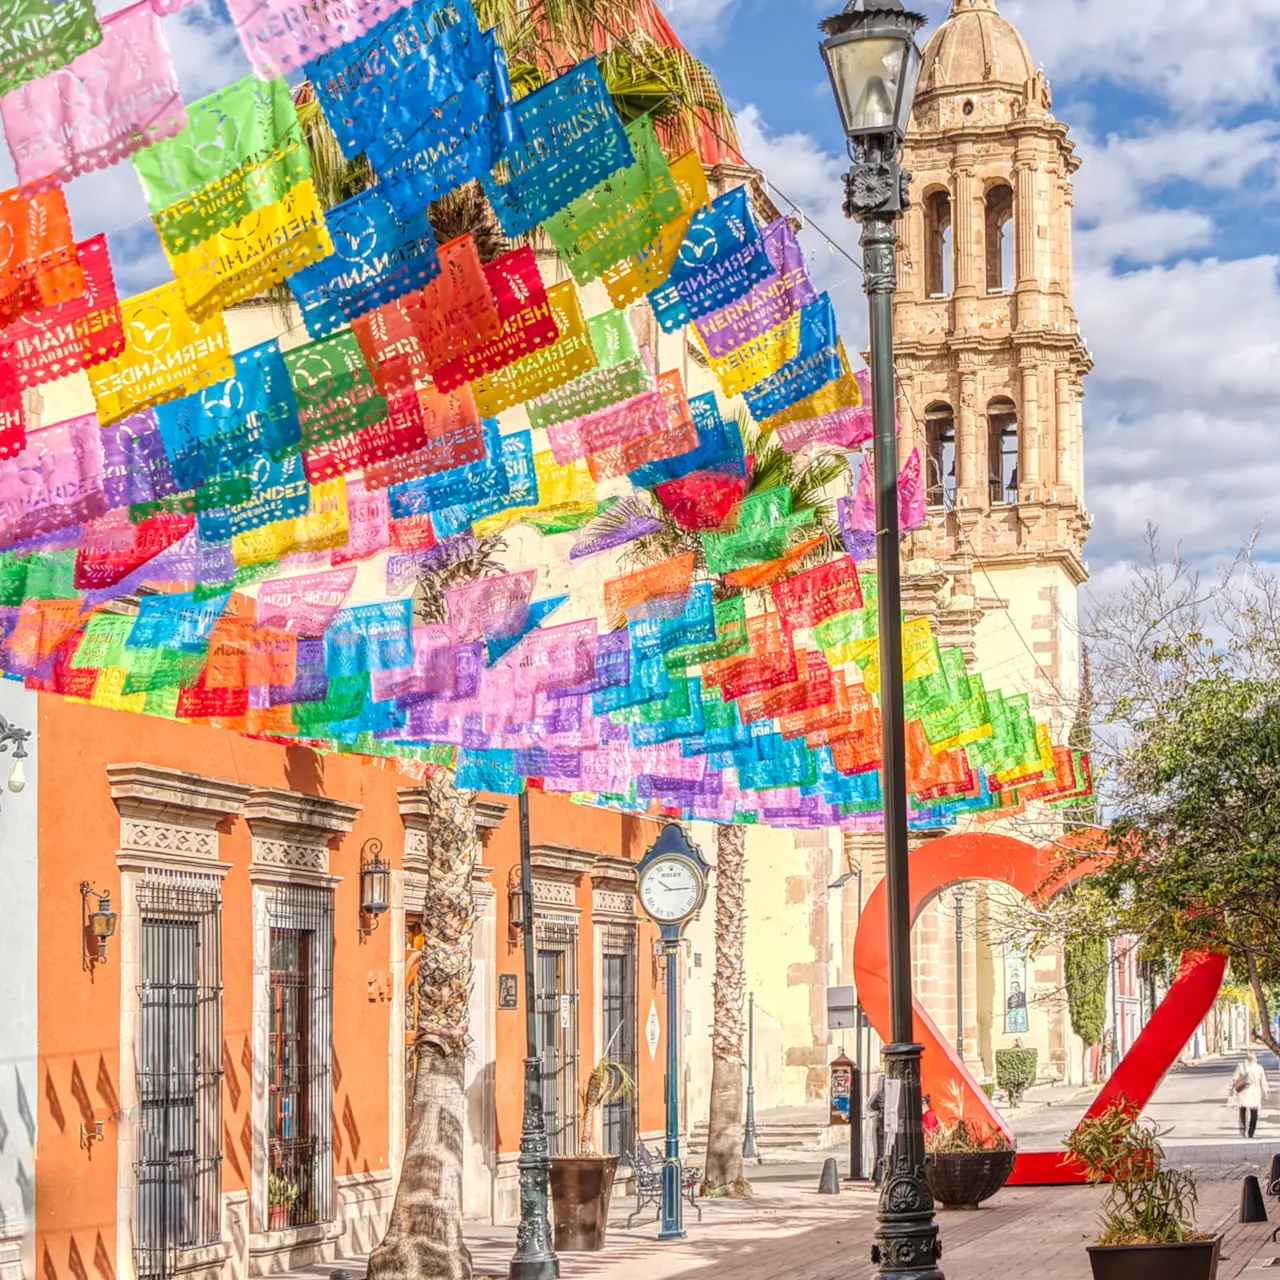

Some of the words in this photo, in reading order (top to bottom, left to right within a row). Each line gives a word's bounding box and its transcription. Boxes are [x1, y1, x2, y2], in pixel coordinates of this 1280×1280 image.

[697, 270, 808, 337] HERNANDEZ
[717, 314, 801, 374] HERNANDE
[504, 458, 528, 478] SHI
